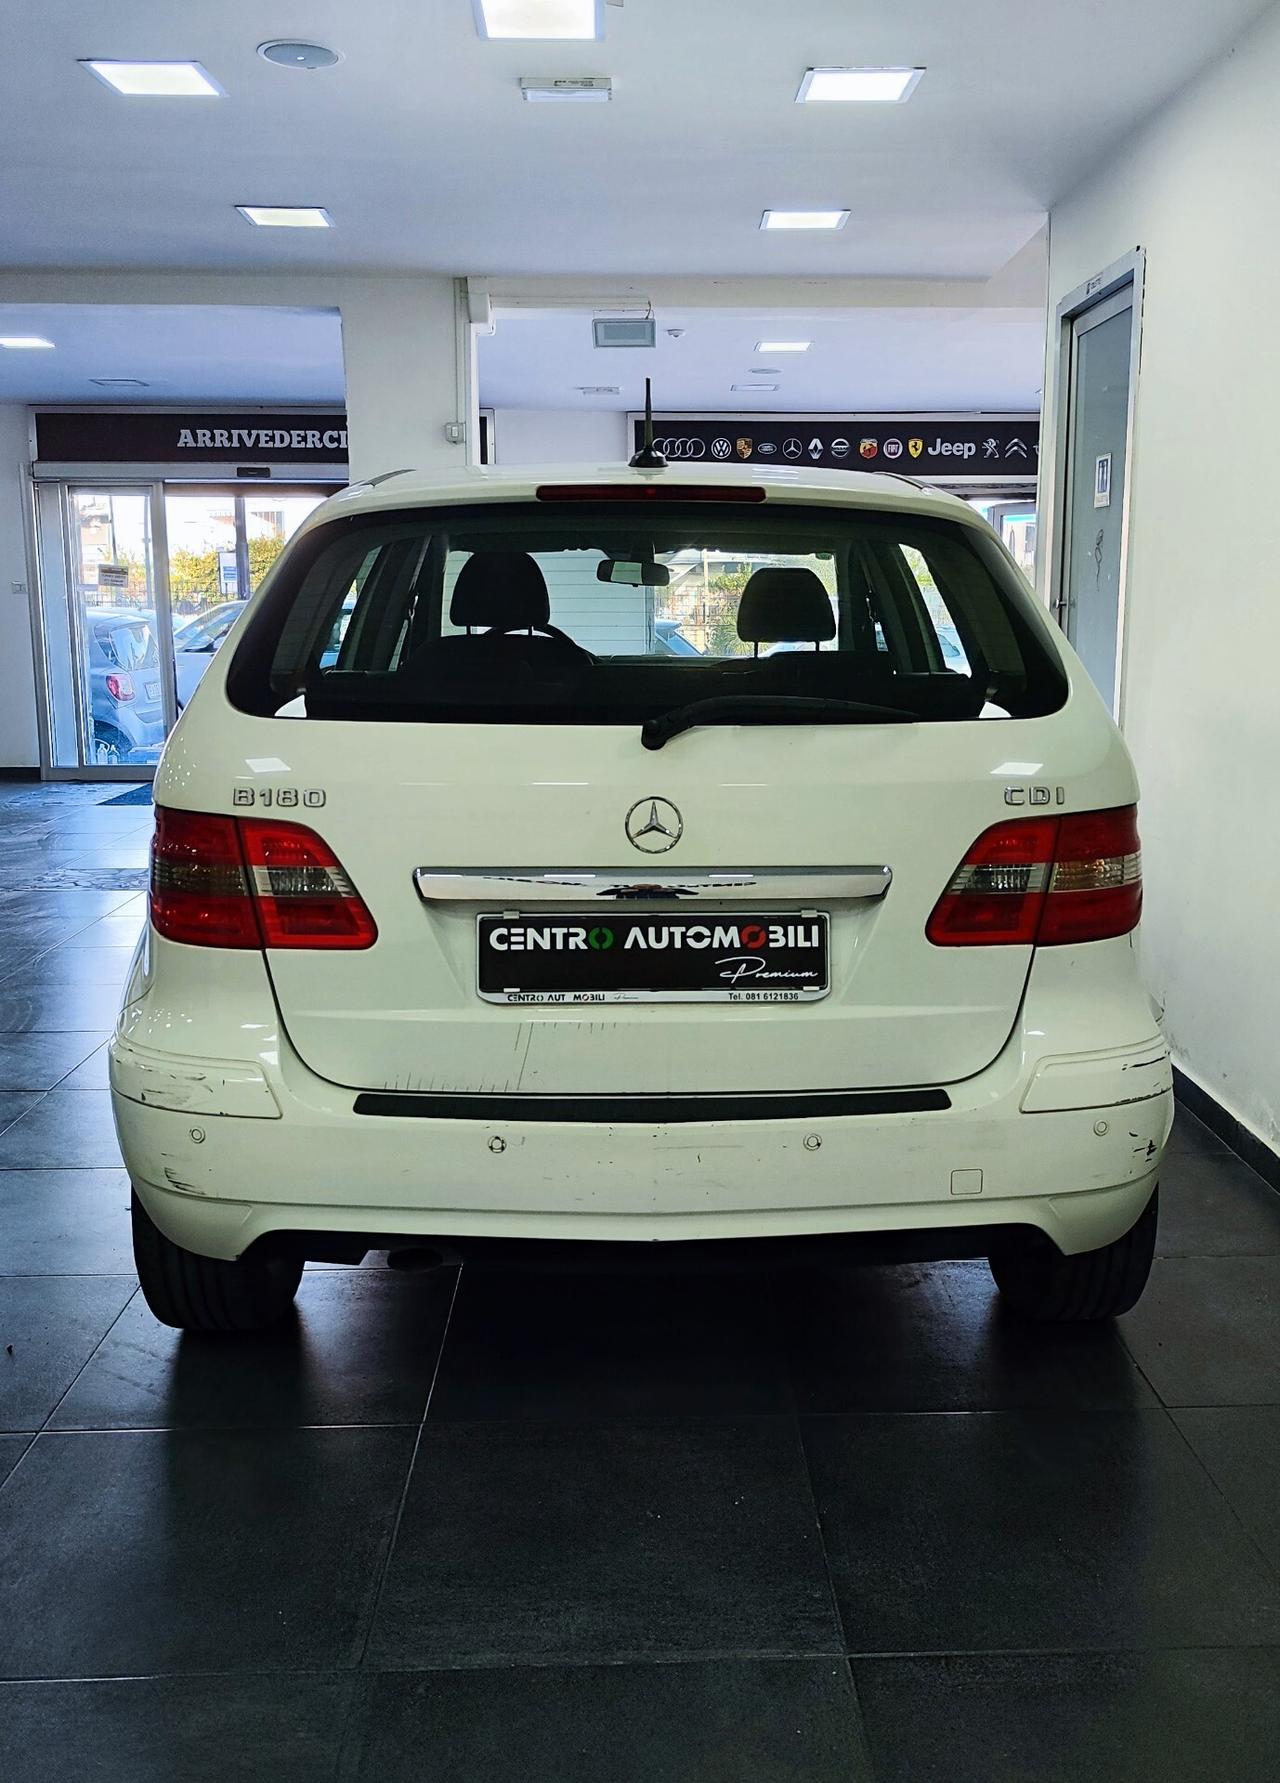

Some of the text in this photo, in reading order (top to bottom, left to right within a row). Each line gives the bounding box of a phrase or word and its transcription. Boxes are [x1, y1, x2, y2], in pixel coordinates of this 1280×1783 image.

[177, 429, 348, 449] ARRIVEDERCI
[927, 438, 977, 459] Jeep
[232, 787, 327, 808] B180
[1003, 786, 1066, 806] CDI
[489, 925, 820, 951] CENTRO AUTOMOBILI
[714, 956, 819, 984] Premium
[507, 993, 545, 1002] CENTRO
[728, 992, 799, 1001] Tel. 081 6121836
